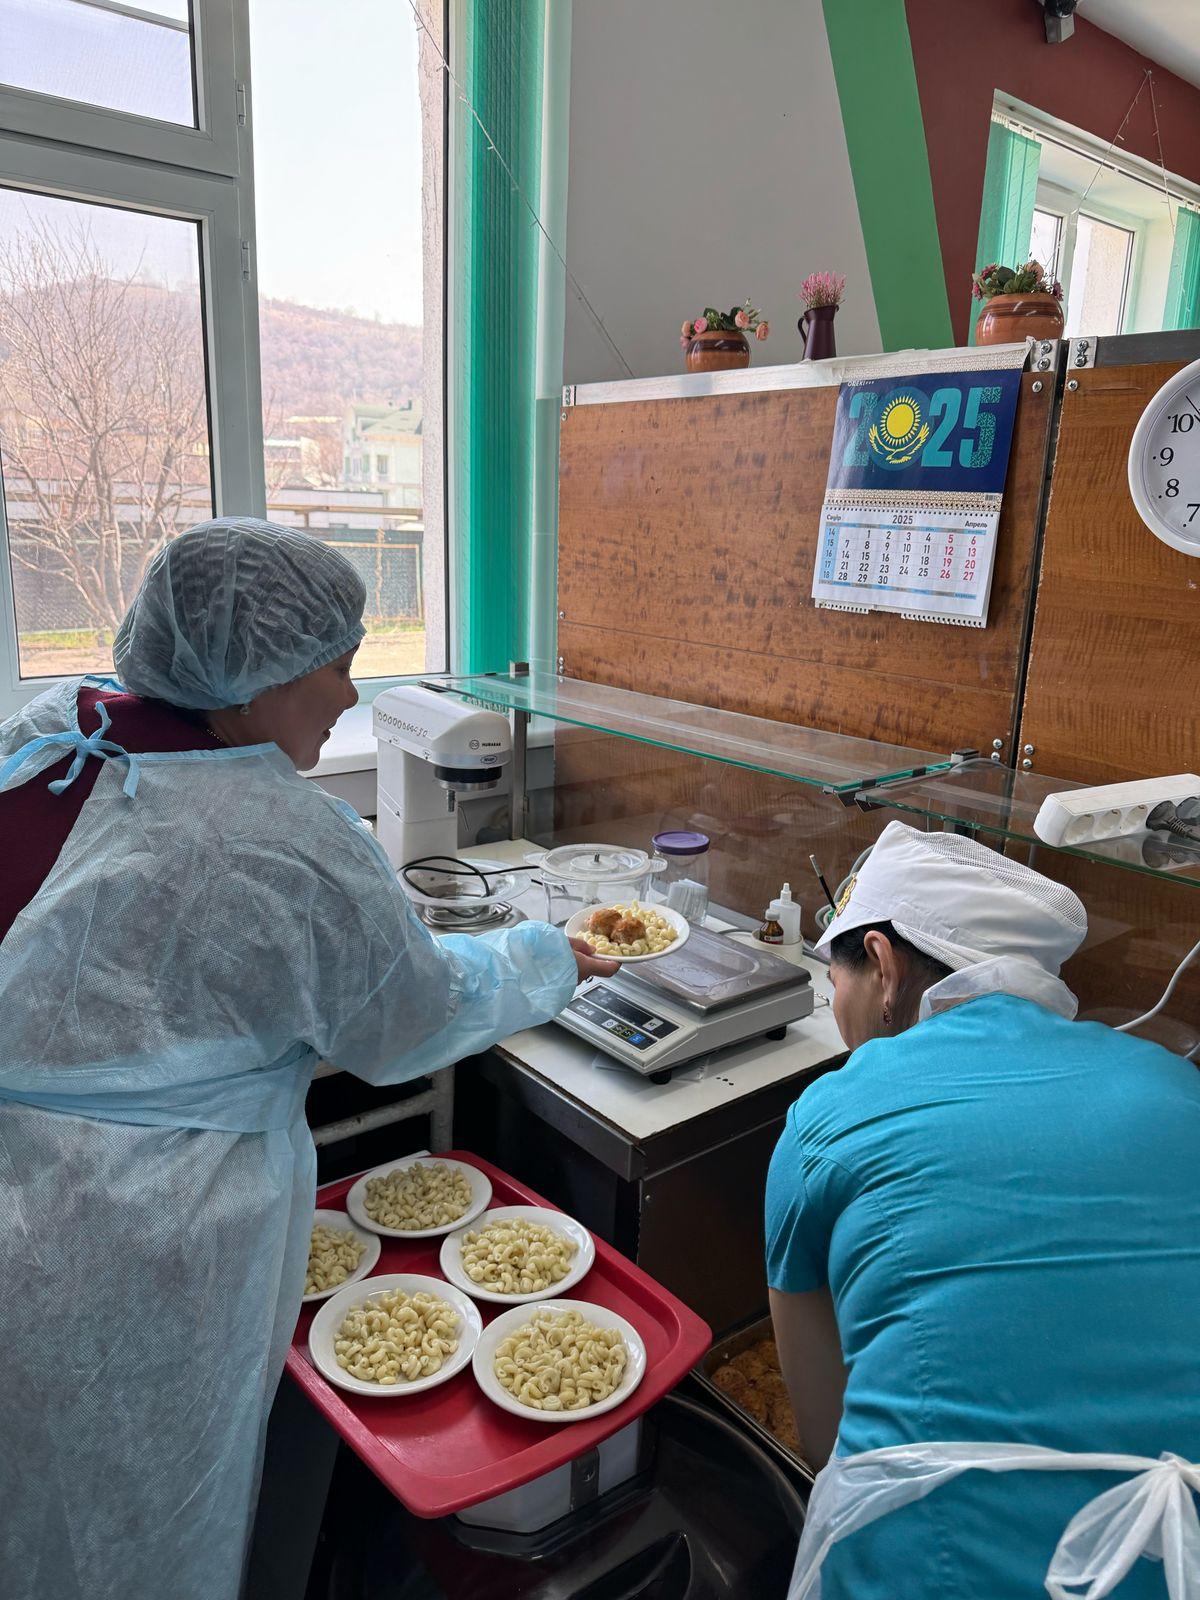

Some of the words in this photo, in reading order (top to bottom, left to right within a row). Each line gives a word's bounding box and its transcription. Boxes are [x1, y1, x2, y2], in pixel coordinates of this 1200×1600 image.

[842, 386, 1002, 470] 14
[1170, 413, 1194, 433] 10
[1160, 447, 1174, 466] 9
[1165, 478, 1180, 498] 8
[892, 515, 914, 524] 2025
[867, 530, 870, 538] 1
[886, 531, 892, 540] 2
[906, 532, 911, 540] 3
[926, 533, 931, 542] 4
[948, 534, 954, 543] 5
[971, 536, 976, 545] 6
[845, 540, 850, 548] 7
[864, 541, 870, 549] 8
[885, 542, 890, 551] 9
[903, 544, 911, 552] 10
[924, 545, 930, 554] 11
[945, 546, 954, 556] 12
[968, 548, 976, 557] 13
[862, 552, 870, 560] 15
[882, 554, 890, 562] 16
[902, 555, 909, 564] 17
[921, 556, 929, 565] 18
[943, 558, 952, 567] 19
[965, 560, 976, 569] 20
[841, 562, 848, 570] 21
[859, 563, 869, 572] 22
[880, 565, 889, 574] 23
[899, 566, 909, 575] 24
[918, 568, 929, 577] 25
[940, 570, 951, 579] 26
[963, 572, 974, 581] 27
[838, 572, 848, 581] 28
[858, 574, 868, 583] 29
[878, 576, 888, 584] 30
